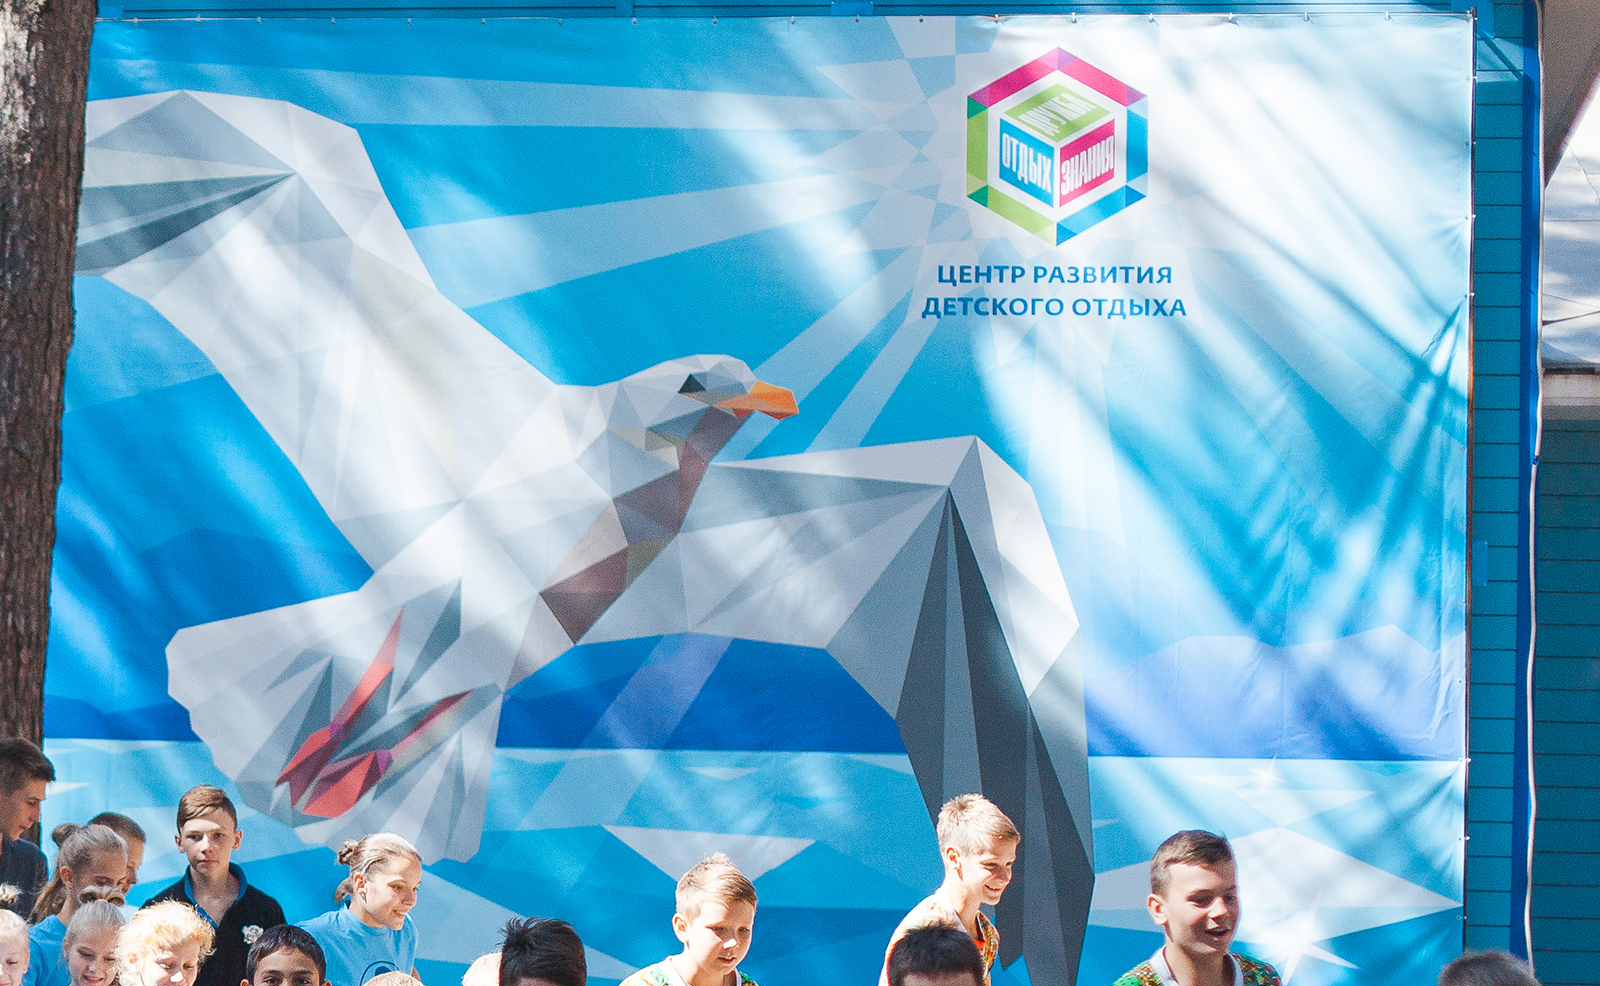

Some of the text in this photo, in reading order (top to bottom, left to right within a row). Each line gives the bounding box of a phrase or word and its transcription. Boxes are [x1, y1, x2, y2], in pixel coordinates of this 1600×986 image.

[1017, 92, 1097, 136] ДРУЖБА
[1002, 132, 1051, 194] ОТДЫХ
[1060, 134, 1114, 196] ЗНАНИЯ
[937, 265, 1172, 287] ЦЕНТР РАЗВИТИЯ
[921, 296, 1187, 320] ДЕТСКОГО ОТДЫХА
